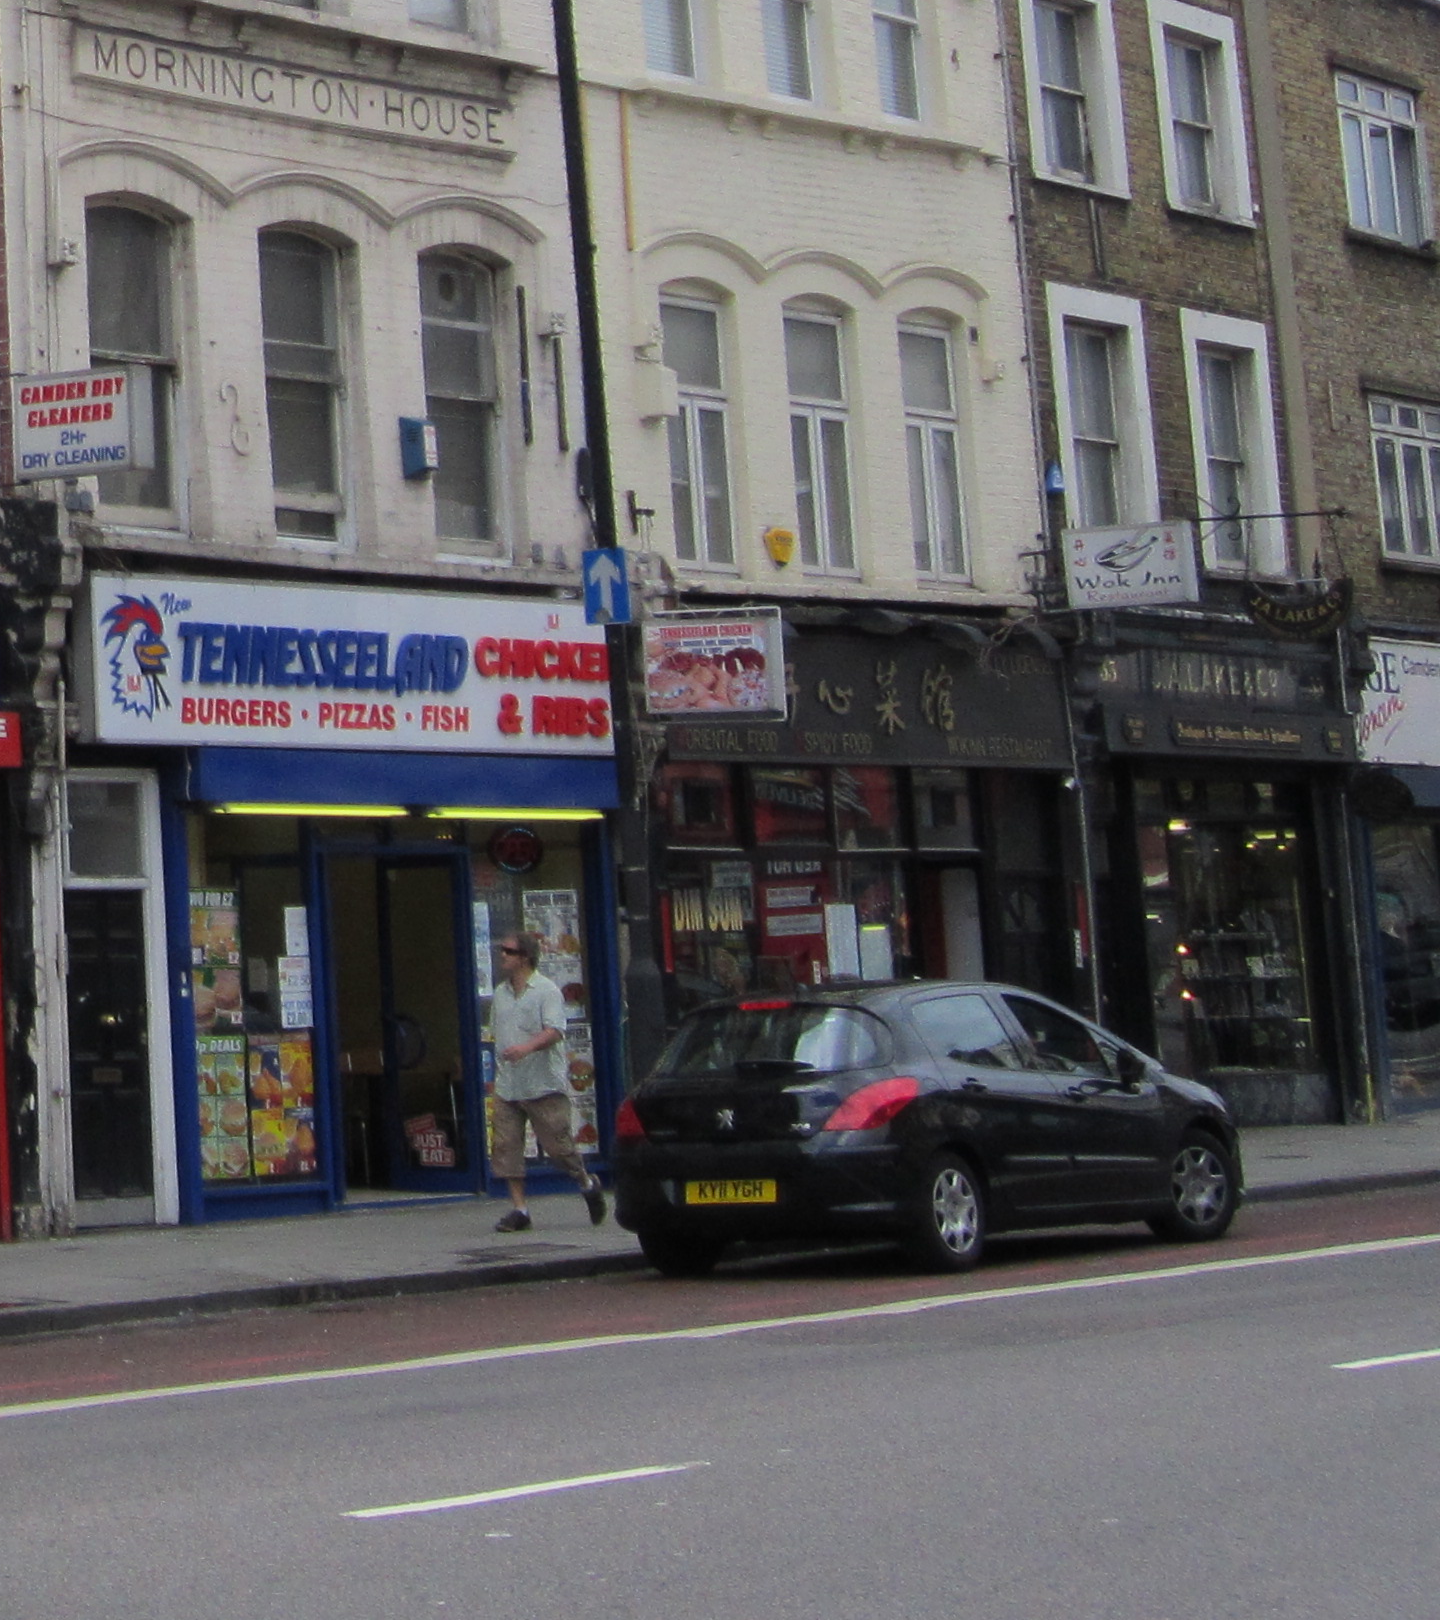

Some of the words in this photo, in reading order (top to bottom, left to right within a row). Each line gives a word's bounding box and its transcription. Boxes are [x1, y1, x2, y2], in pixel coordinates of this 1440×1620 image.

[93, 33, 360, 120] MORNINGTON
[383, 88, 505, 145] HOUSE
[20, 380, 88, 406] CAMDEN
[92, 376, 126, 398] DRY
[27, 402, 114, 428] CLEANERS
[60, 430, 87, 447] 2Hr
[22, 453, 51, 469] DRY
[55, 445, 127, 467] CLEANING
[1075, 573, 1131, 590] Wok
[1142, 570, 1182, 586] Inn
[159, 592, 192, 616] New
[177, 621, 470, 698] TENNESSEELAND
[181, 697, 292, 730] BURGERS
[319, 702, 396, 731] PIZZAS
[421, 705, 470, 733] FISH
[497, 693, 525, 736] &
[531, 695, 612, 739] RIBS
[747, 729, 778, 753] FOOD
[841, 731, 873, 755] FOOD
[672, 888, 704, 931] DIM
[707, 887, 744, 931] SUM
[415, 1133, 444, 1149] JUST
[422, 1148, 445, 1163] EAT
[731, 1180, 763, 1198] YGH
